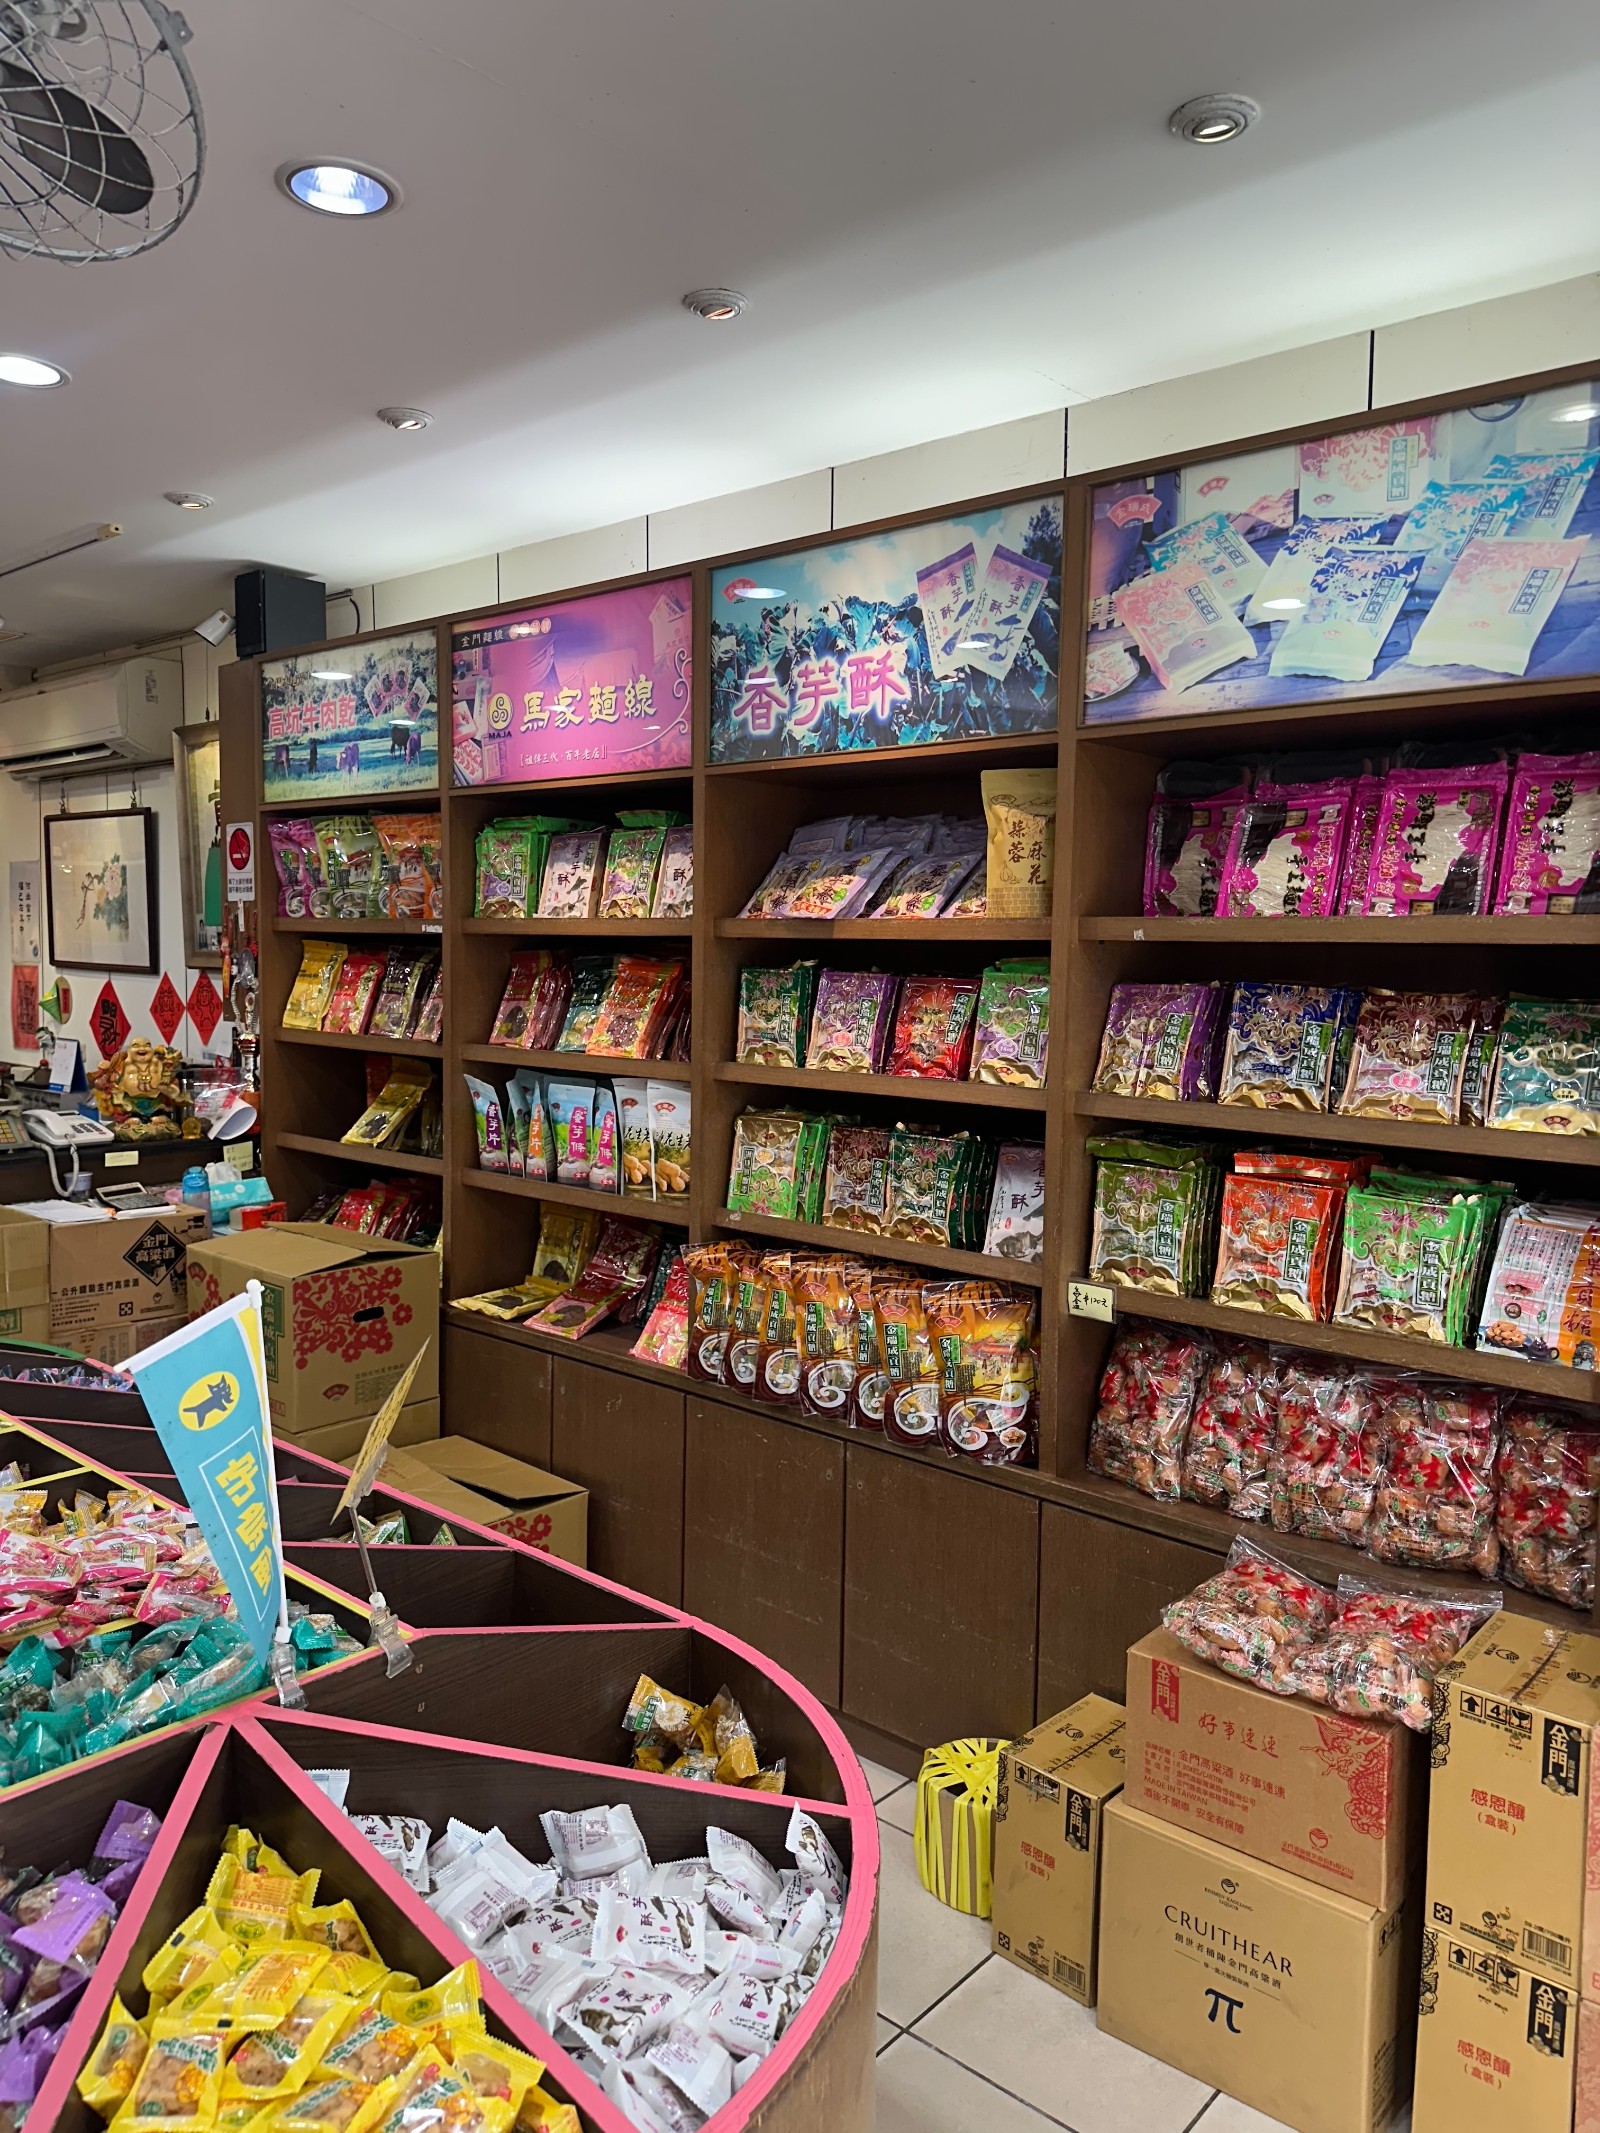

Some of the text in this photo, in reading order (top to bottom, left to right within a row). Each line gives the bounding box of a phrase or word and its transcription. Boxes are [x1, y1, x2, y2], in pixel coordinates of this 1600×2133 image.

[461, 630, 504, 647] 金門麵線
[269, 696, 357, 738] 高坑牛肉乾
[520, 674, 656, 732] 馬家麵線
[734, 650, 906, 732] 香芋酥
[489, 731, 512, 740] MAJA
[1008, 820, 1046, 885] 蒜蓉 麻花
[1300, 1024, 1322, 1080] 金瑞成貢糖
[1430, 1034, 1453, 1091] 金瑞成貢糖
[934, 1170, 949, 1218] 金瑞成貢糖
[142, 1234, 169, 1248] 金門
[1158, 1201, 1174, 1257] 金瑞成貢糖
[1287, 1220, 1308, 1280] 金瑞成貢糖
[1418, 1240, 1440, 1303] 金瑞成貢糖
[886, 1325, 900, 1378] 金瑞成貢糖
[215, 1452, 272, 1596] 宅急便
[1156, 1664, 1170, 1708] 金門
[1179, 1749, 1234, 1779] 金門高粱酒
[1549, 1724, 1569, 1778] 金門
[1070, 1794, 1083, 1837] 金門
[1144, 1775, 1208, 1806] MADE IN TAIWAN
[1470, 1788, 1526, 1822] 感恩釀
[1165, 1905, 1292, 1977] CRUITHEAR
[1205, 1988, 1243, 2033] π
[1535, 1984, 1555, 2039] 金門
[1457, 2039, 1511, 2078] 感恩釀
